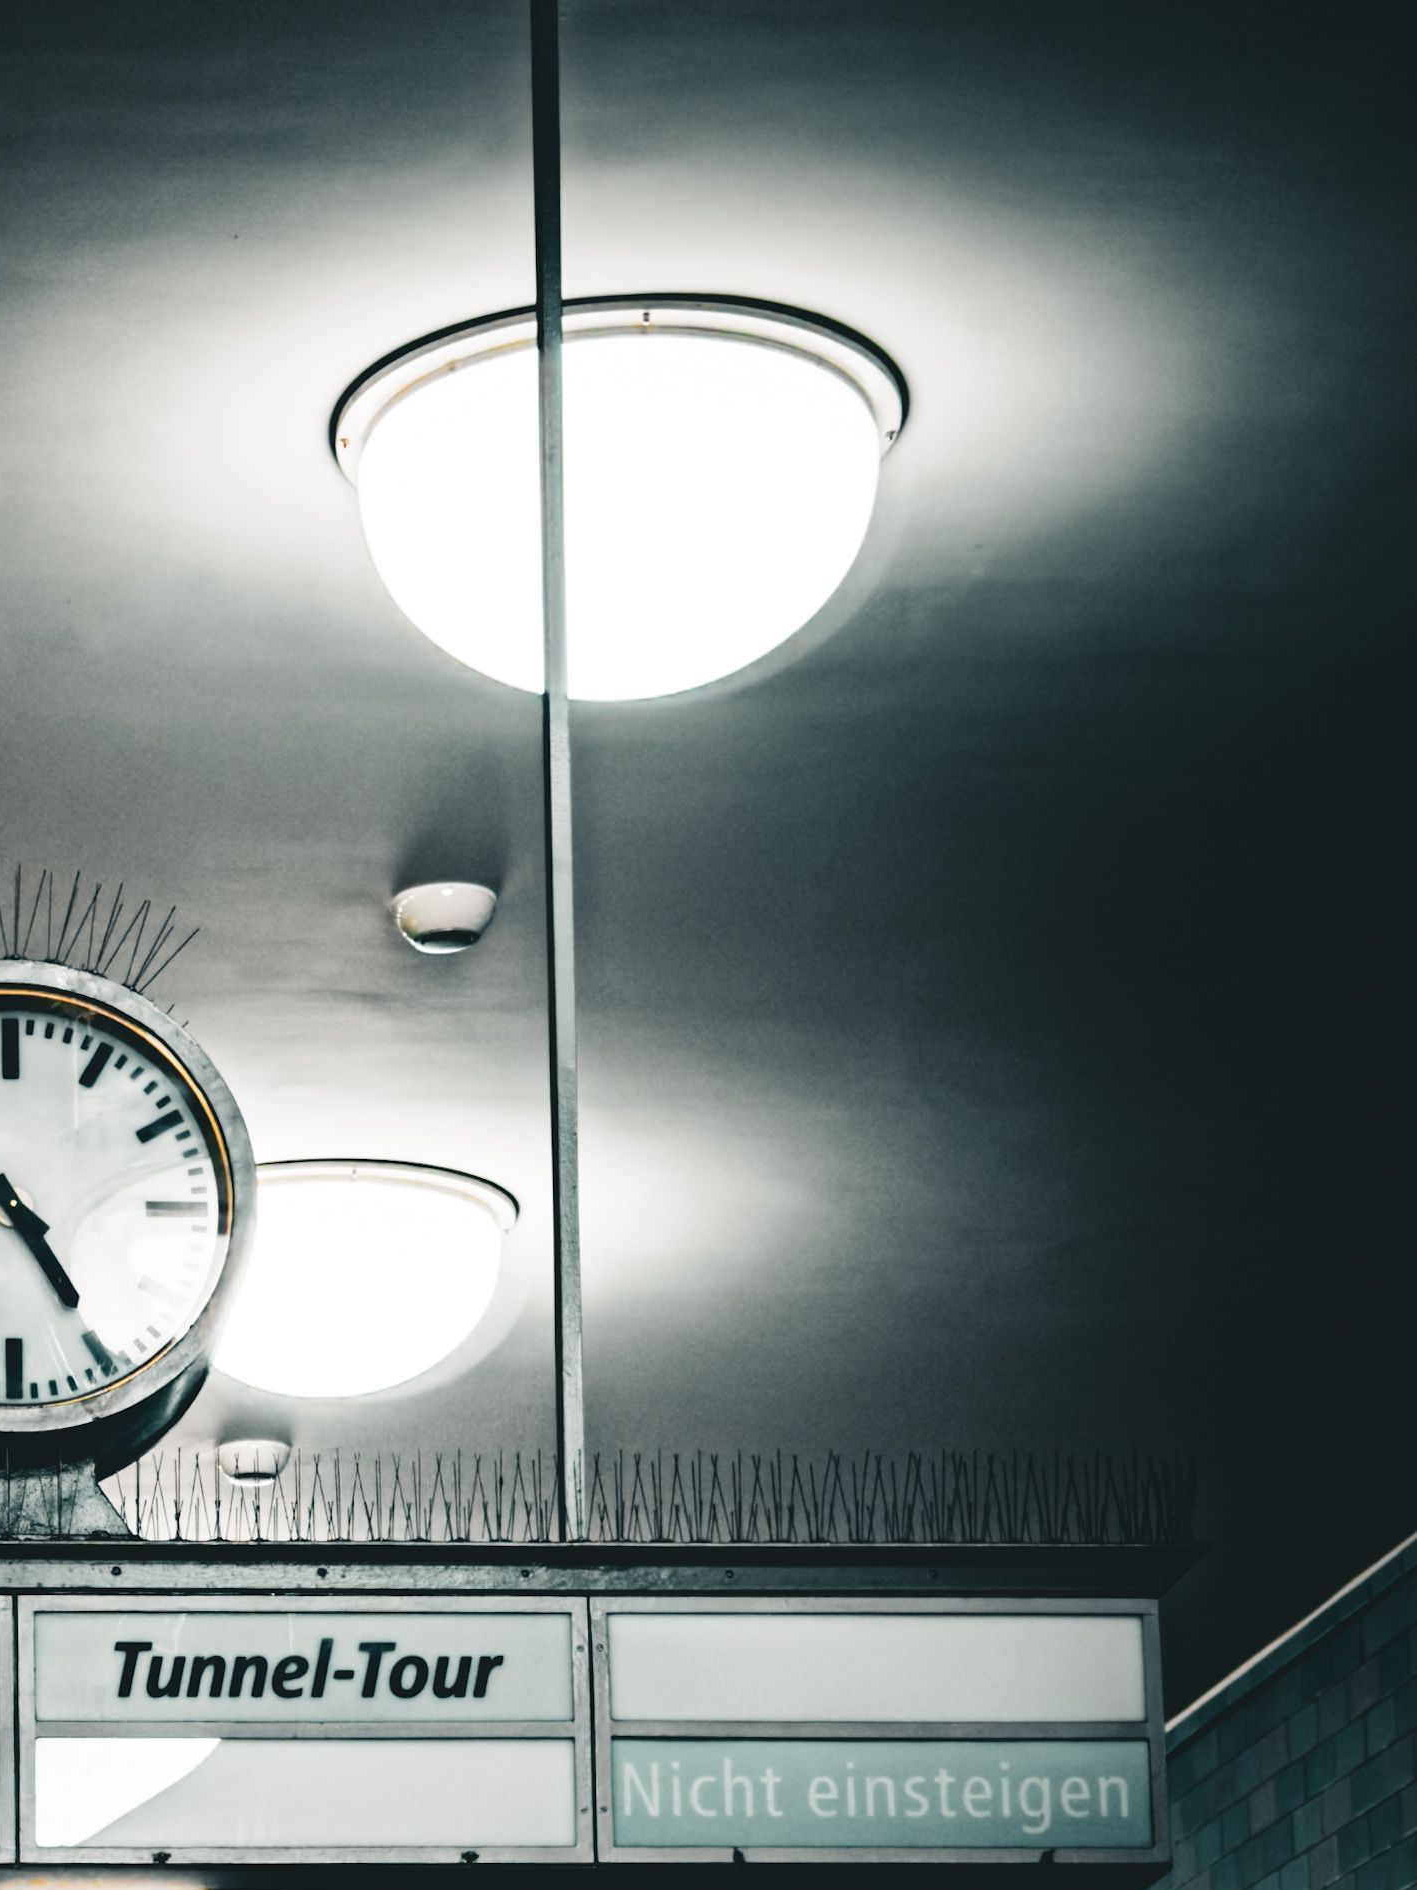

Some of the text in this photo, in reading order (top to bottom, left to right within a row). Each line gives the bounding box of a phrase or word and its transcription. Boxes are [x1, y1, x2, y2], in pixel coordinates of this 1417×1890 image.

[114, 1638, 504, 1699] Tunnel-Tour
[620, 1758, 1131, 1833] Nicht einsteigen
